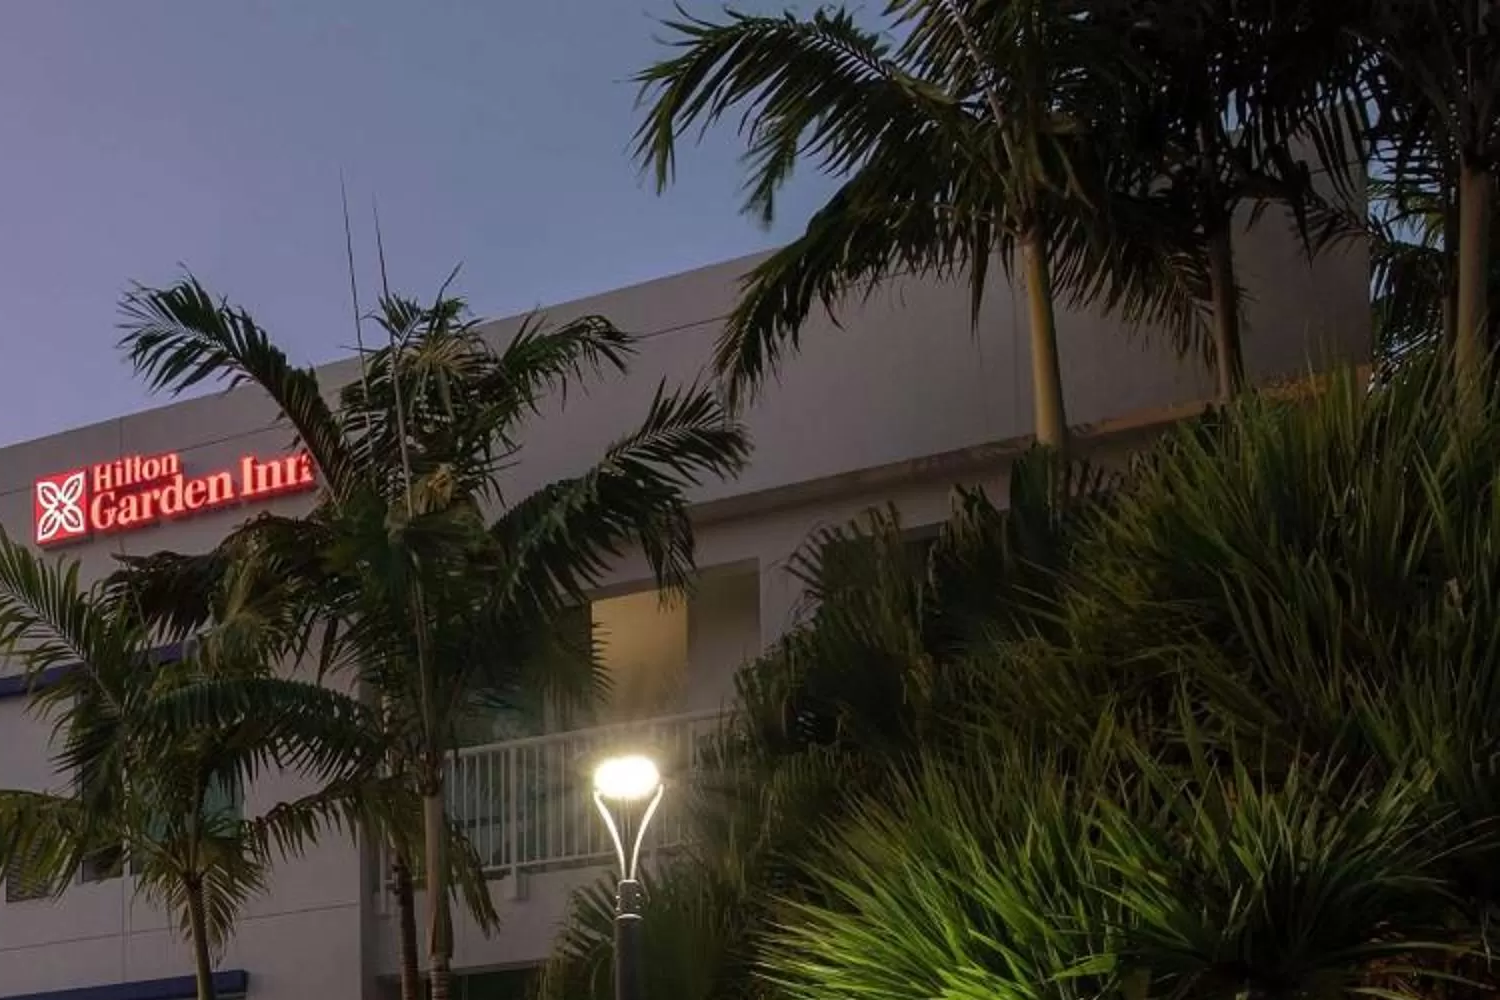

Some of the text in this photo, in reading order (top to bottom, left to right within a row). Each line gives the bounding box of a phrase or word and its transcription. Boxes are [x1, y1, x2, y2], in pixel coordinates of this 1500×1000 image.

[90, 453, 314, 529] Garden Inn
[93, 453, 179, 492] Hilton
